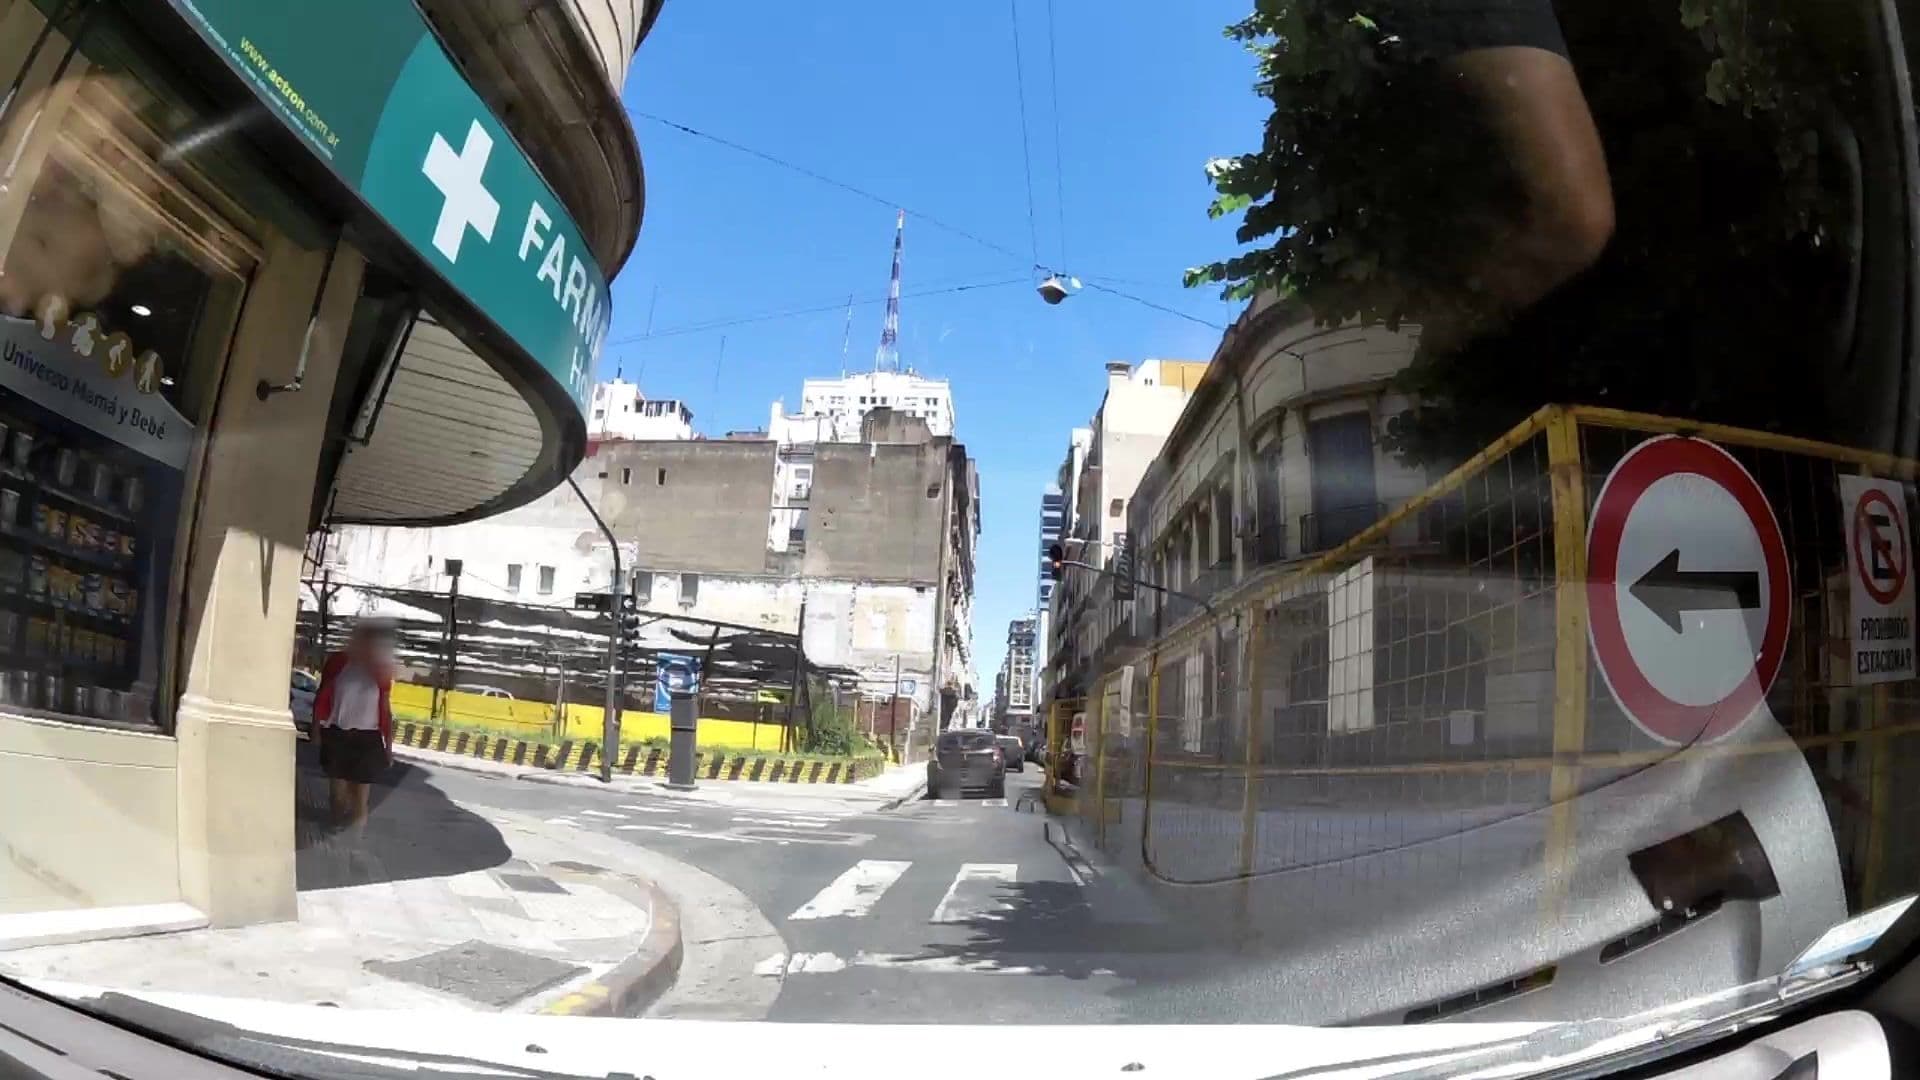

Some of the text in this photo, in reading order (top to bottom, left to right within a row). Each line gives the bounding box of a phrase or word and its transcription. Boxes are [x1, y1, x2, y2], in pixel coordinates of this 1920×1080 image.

[240, 36, 341, 148] www.actron.com.ar
[71, 378, 118, 417] Mamá
[118, 408, 129, 425] y
[130, 407, 167, 440] Bebé
[1857, 647, 1912, 675] ESTACIONAR
